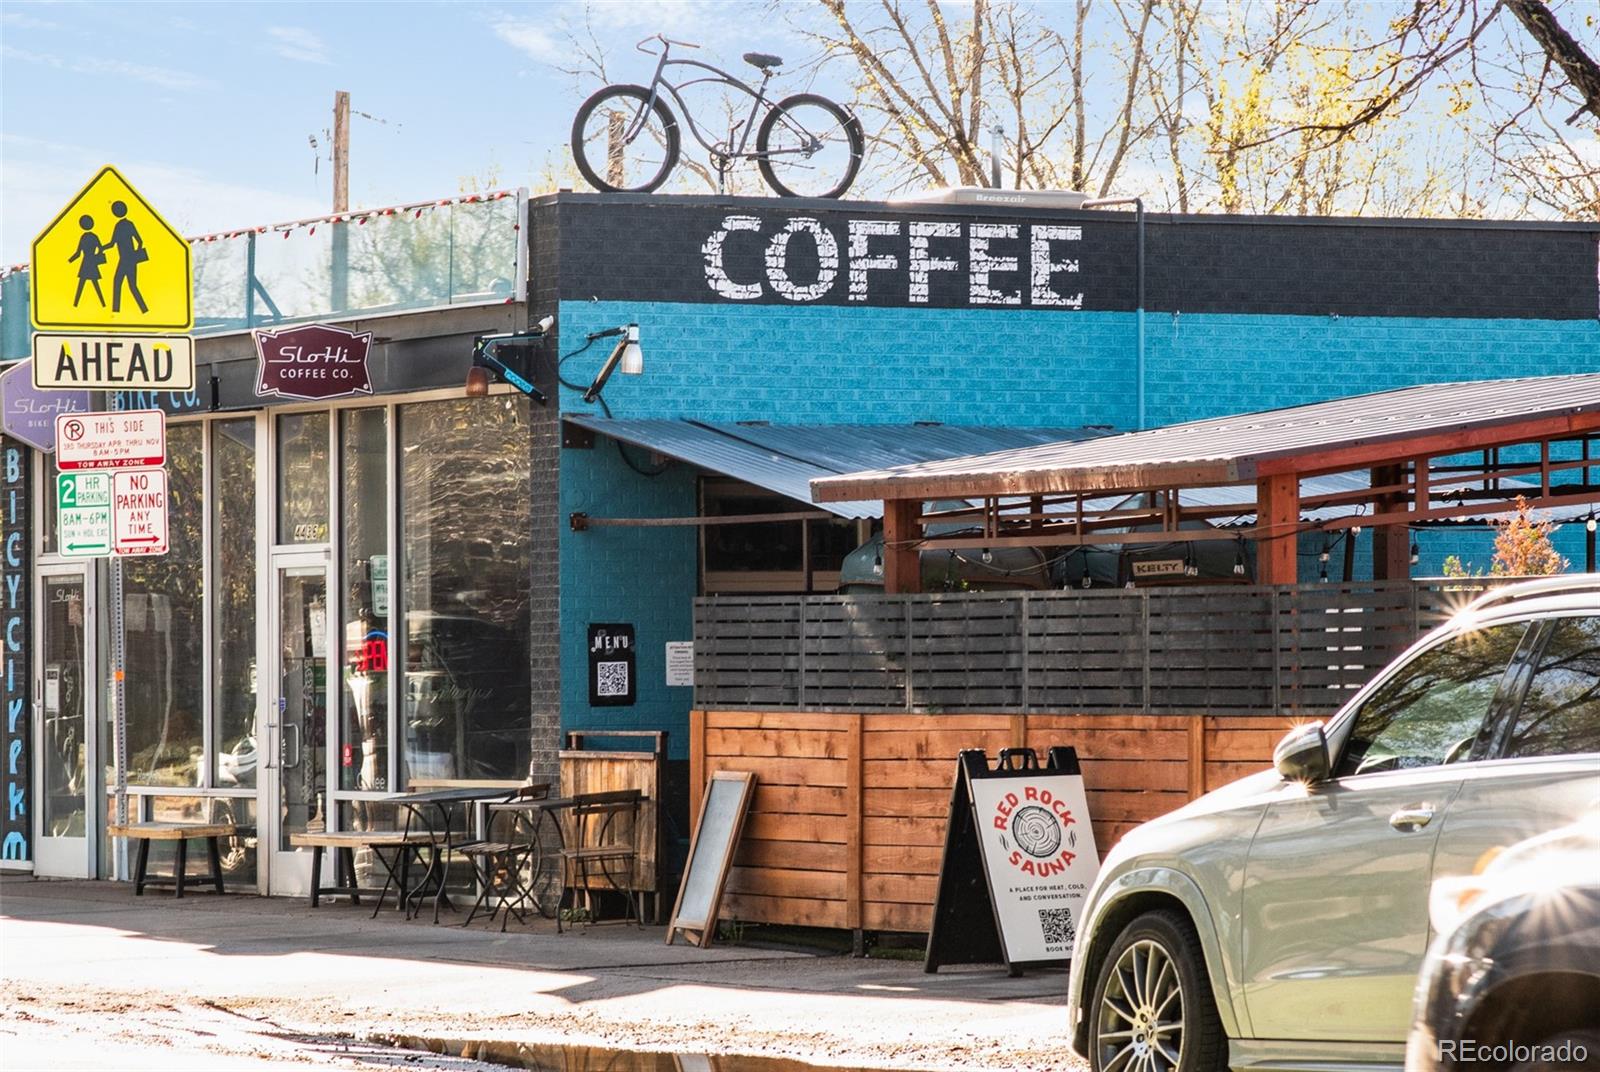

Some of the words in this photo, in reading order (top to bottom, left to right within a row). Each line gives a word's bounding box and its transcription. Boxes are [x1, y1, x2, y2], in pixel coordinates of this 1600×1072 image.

[702, 215, 1083, 310] COFFEE
[55, 341, 173, 382] AHEAD
[268, 346, 361, 363] SloHi
[280, 368, 327, 379] COFFEE
[332, 368, 353, 379] CO.
[8, 398, 86, 414] SloHi
[28, 420, 49, 428] BIKE
[95, 421, 115, 434] THIS
[124, 420, 144, 433] SIDE
[126, 438, 143, 446] THRU
[97, 460, 119, 468] AWAY
[123, 458, 145, 466] ZONE
[129, 475, 149, 490] NO
[61, 479, 75, 504] 2
[84, 477, 100, 490] HR
[77, 491, 108, 504] PARKING
[117, 492, 163, 510] PARKING
[130, 511, 151, 522] ANY
[128, 523, 153, 535] TIME
[1136, 562, 1179, 573] KELTY
[594, 635, 628, 649] MENU
[994, 793, 1019, 830] RED
[1025, 787, 1076, 827] ROCK
[1009, 850, 1076, 877] SAUNA
[1033, 893, 1082, 901] CONVERSATION.
